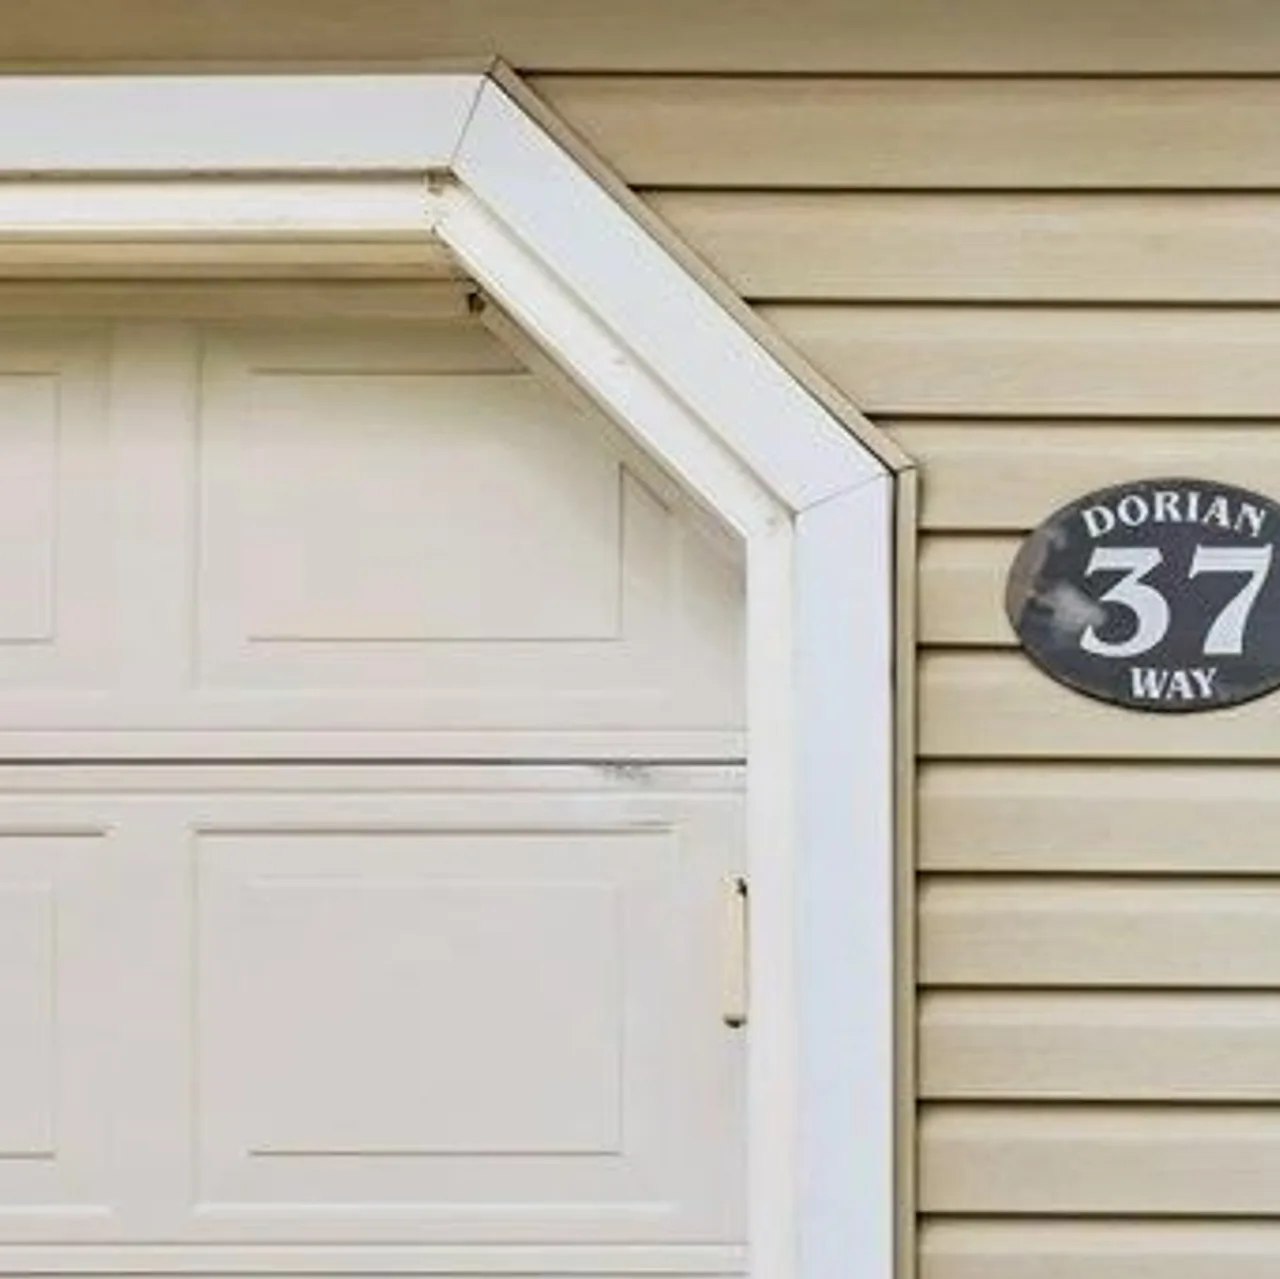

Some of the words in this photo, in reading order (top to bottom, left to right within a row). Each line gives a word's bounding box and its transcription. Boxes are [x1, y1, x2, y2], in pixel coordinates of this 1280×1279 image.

[1081, 490, 1267, 538] DORIAN
[1079, 543, 1274, 658] 37
[1130, 667, 1217, 700] WAY
